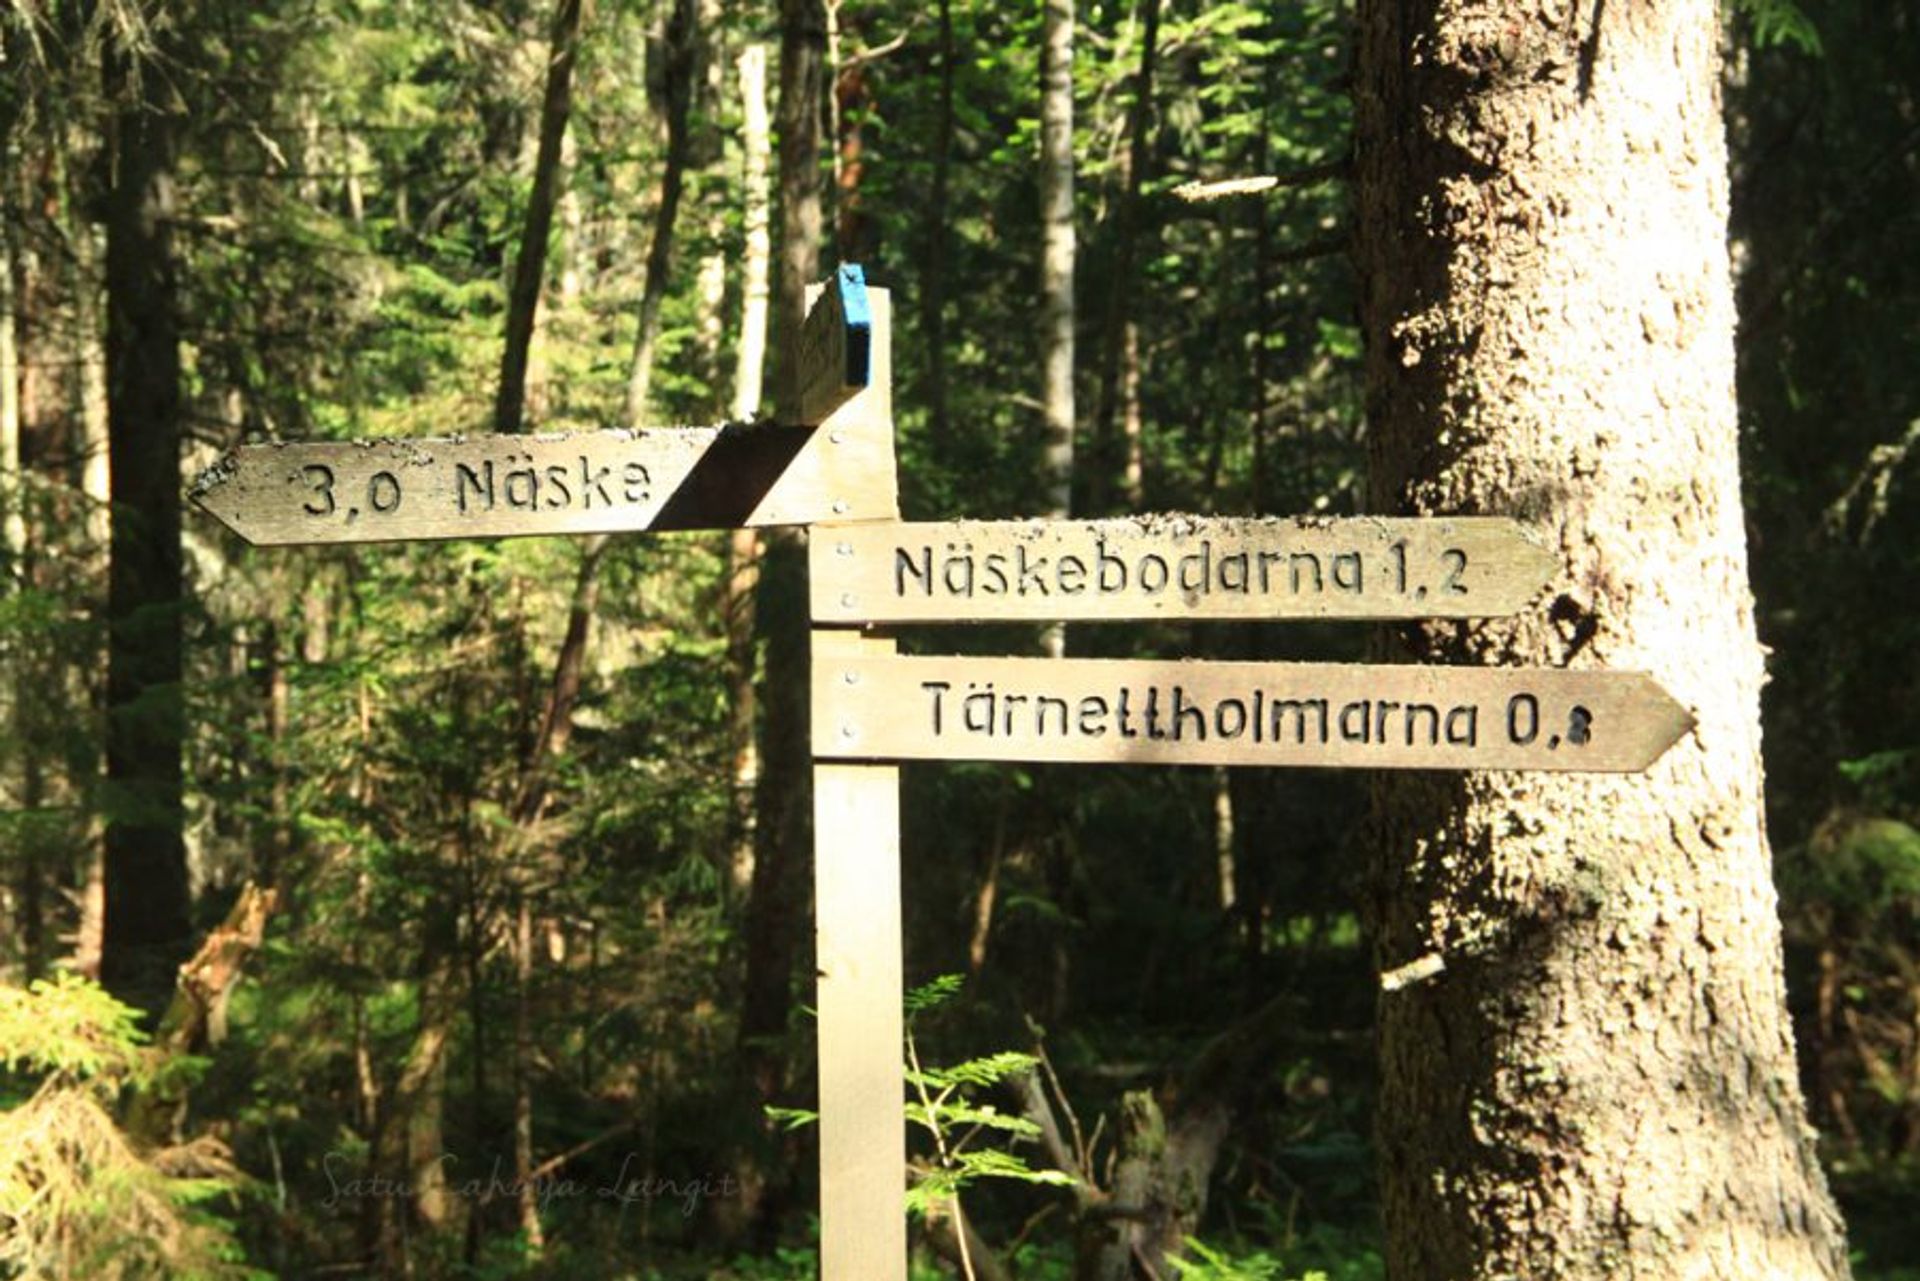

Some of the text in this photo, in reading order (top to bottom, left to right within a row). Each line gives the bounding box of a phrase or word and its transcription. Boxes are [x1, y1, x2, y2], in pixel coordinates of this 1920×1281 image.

[455, 455, 650, 514] Näske
[894, 539, 1468, 601] Näskebodarna 1,2
[921, 681, 1478, 747] Tärnettholmarna
